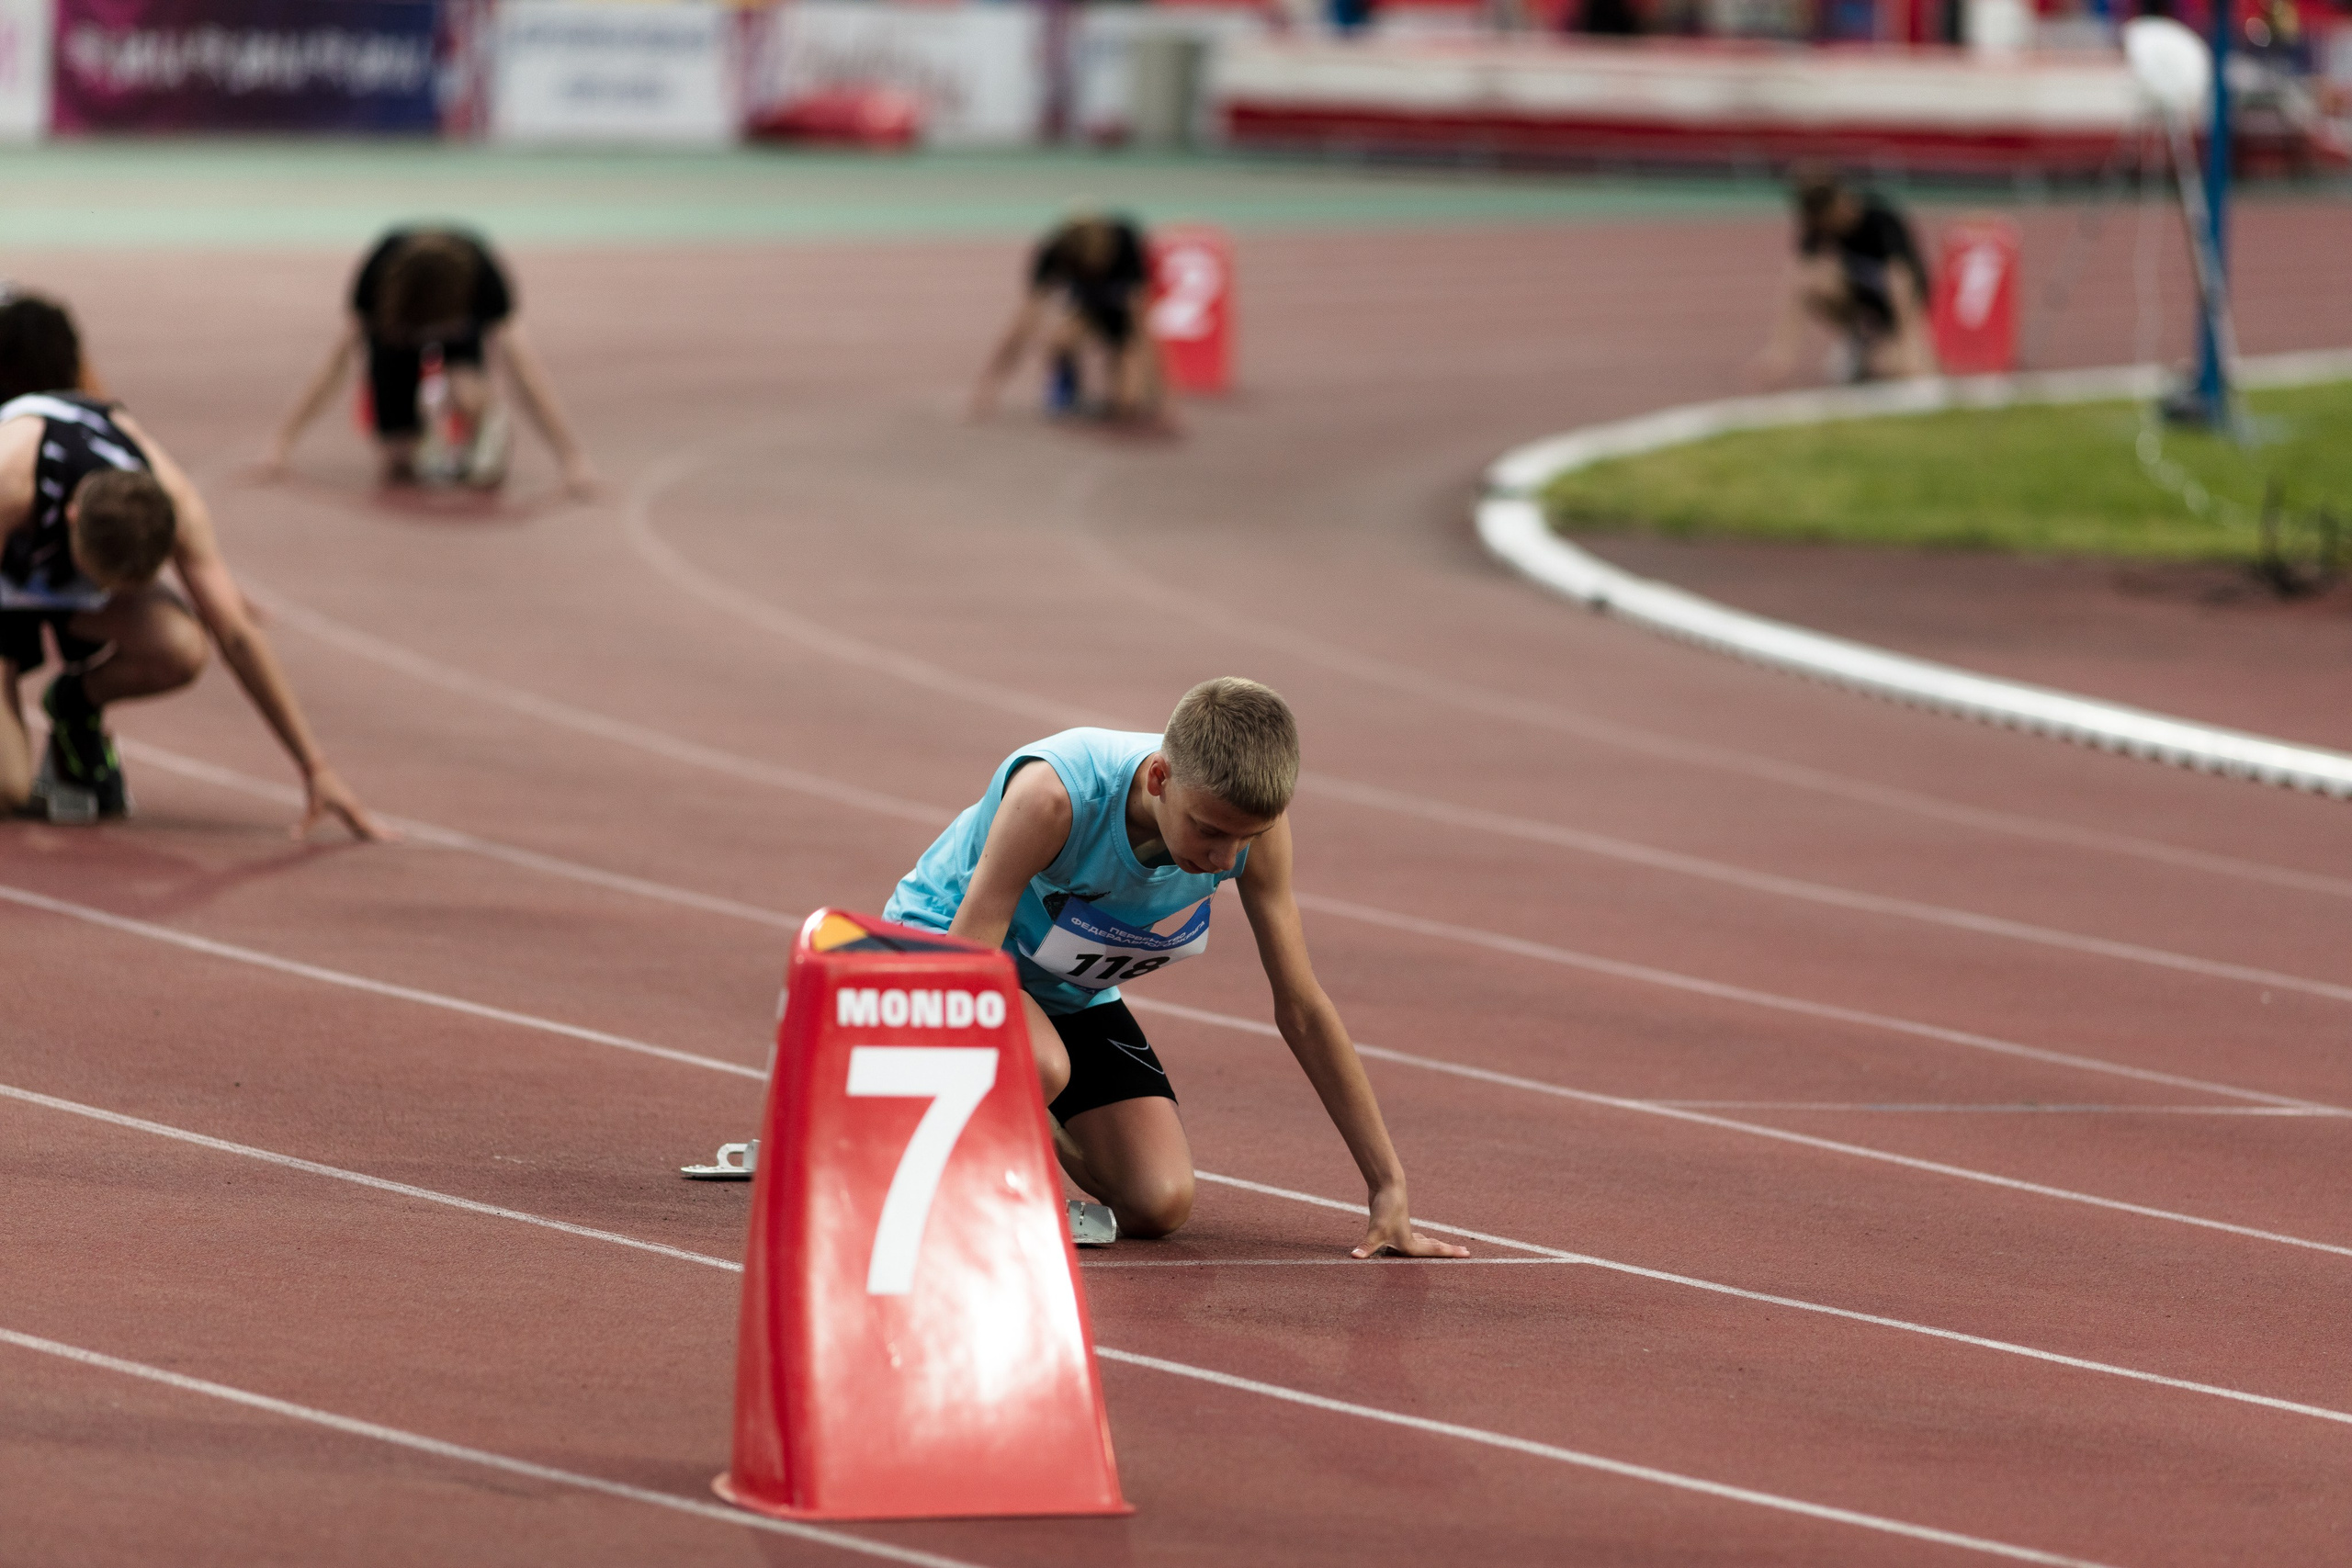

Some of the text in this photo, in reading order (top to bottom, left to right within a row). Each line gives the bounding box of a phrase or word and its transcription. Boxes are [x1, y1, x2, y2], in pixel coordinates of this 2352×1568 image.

[1152, 248, 1217, 337] 2
[1070, 917, 1170, 948] ФЕДЕРАЛЬНОГО
[1109, 927, 1186, 945] ПЕРВЕНСТВО
[1067, 953, 1170, 980] 118
[837, 988, 1006, 1028] MONDO
[846, 1047, 999, 1294] 7
